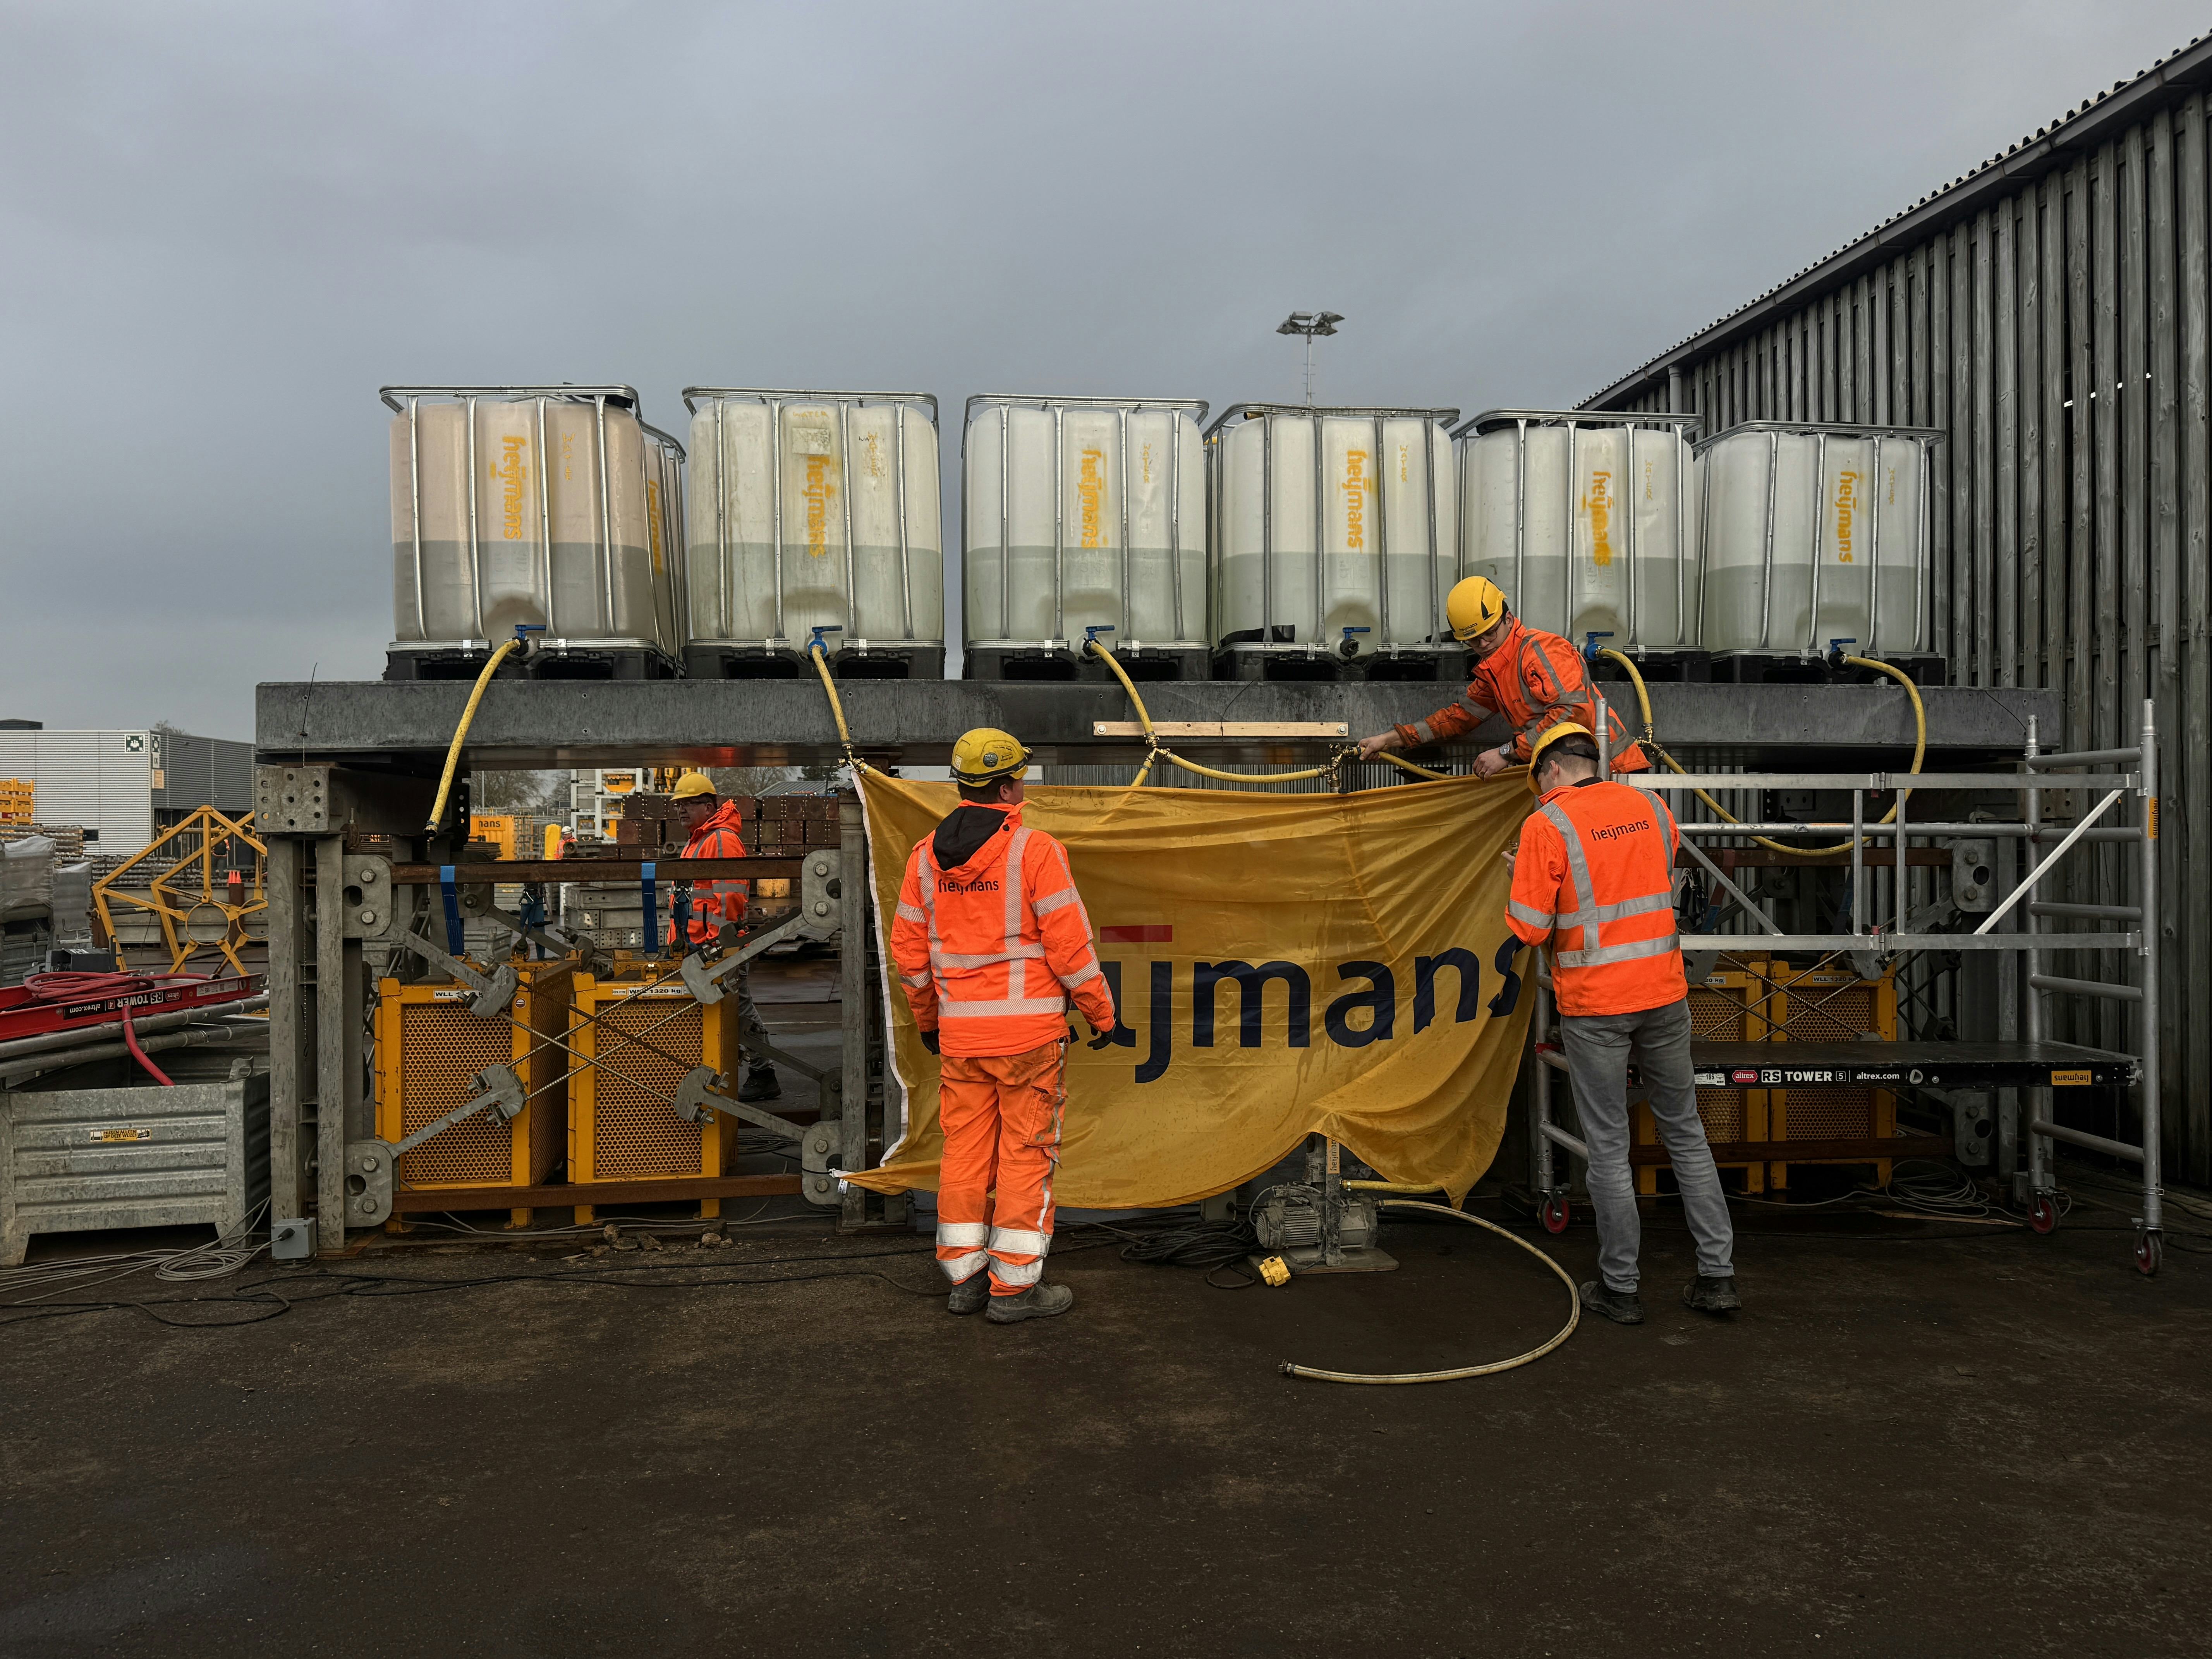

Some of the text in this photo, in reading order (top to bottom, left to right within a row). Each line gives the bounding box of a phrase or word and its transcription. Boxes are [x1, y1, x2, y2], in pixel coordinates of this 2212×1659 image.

[117, 995, 148, 1007] TOWER
[151, 992, 162, 1001] RS
[69, 1003, 100, 1013] altrex.com
[1763, 1071, 1780, 1081] RS
[1784, 1071, 1832, 1081] TOWER
